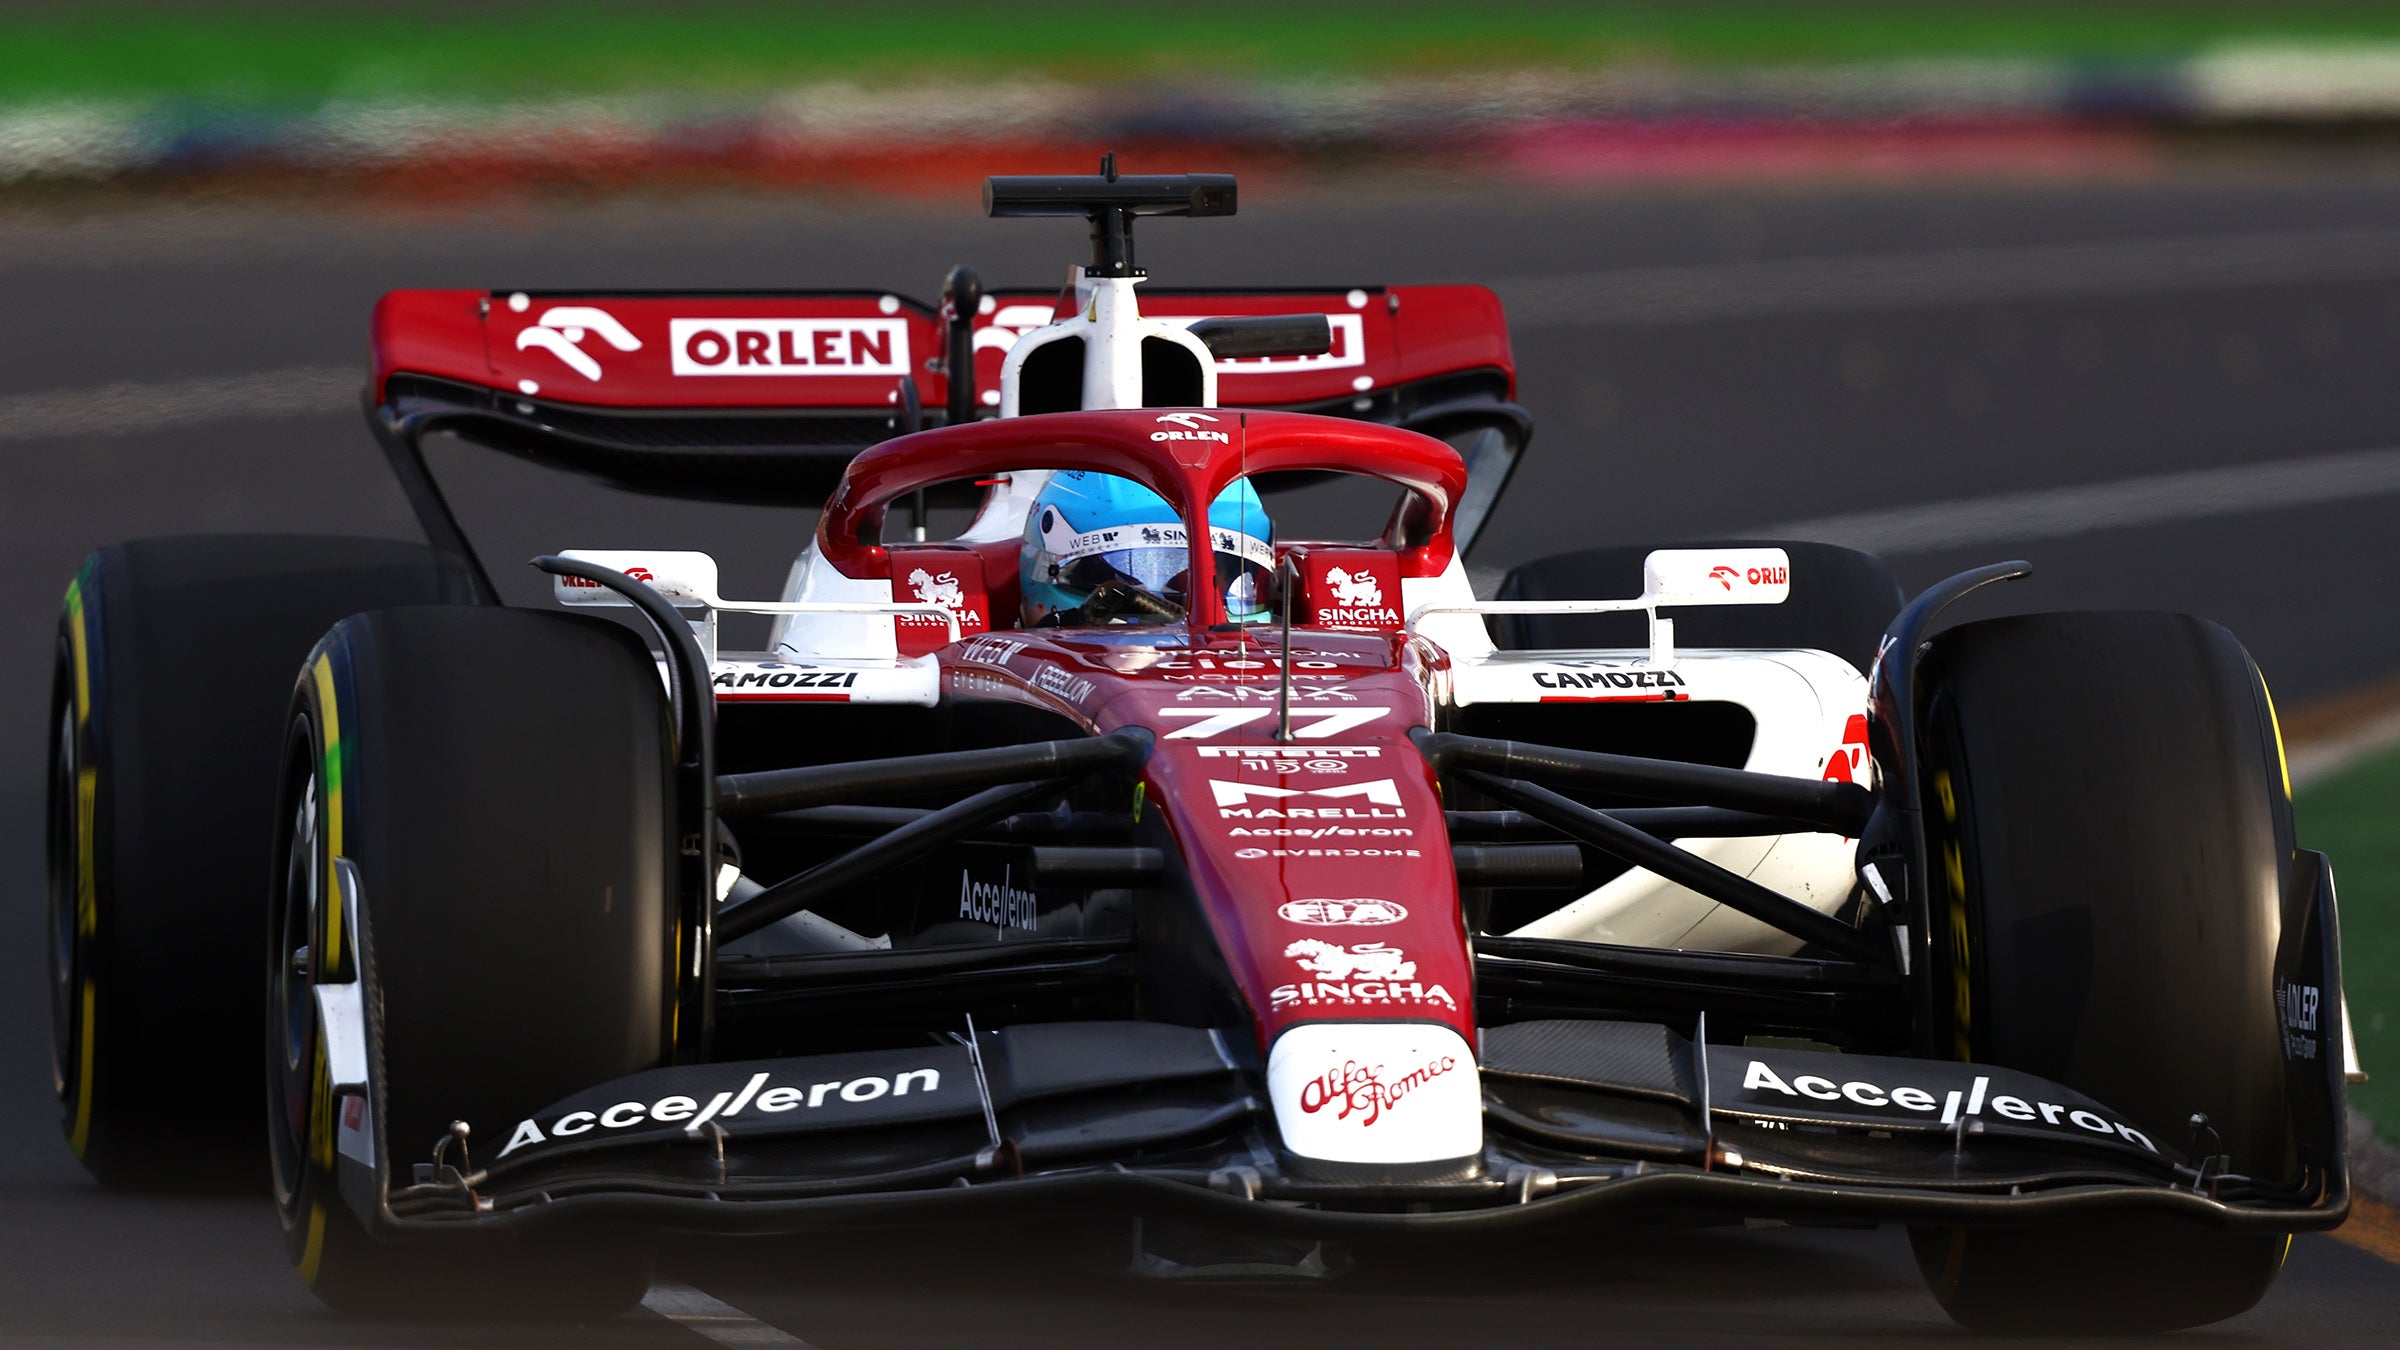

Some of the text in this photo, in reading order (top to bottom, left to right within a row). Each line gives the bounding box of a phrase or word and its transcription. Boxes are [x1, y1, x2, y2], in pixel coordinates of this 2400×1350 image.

[685, 329, 893, 367] ORLEN
[1150, 430, 1229, 445] ORLEN
[562, 574, 603, 588] ORLE
[1318, 608, 1399, 621] SINGHA
[712, 672, 859, 688] AMOZZI
[1532, 670, 1686, 688] CAMOZZI
[1176, 685, 1358, 697] AMX
[1158, 707, 1392, 739] 77
[1197, 746, 1382, 757] PIRELLI
[1218, 807, 1407, 819] MARELLI
[1228, 825, 1414, 839] Accelleron
[1272, 848, 1422, 858] EVERDOME
[959, 863, 1038, 942] Accelleron
[1269, 982, 1456, 1006] SINGHA
[1300, 1055, 1456, 1127] Alfa Romeo
[496, 1066, 941, 1159] Accelleron
[1742, 1060, 2161, 1154] Accelleron
